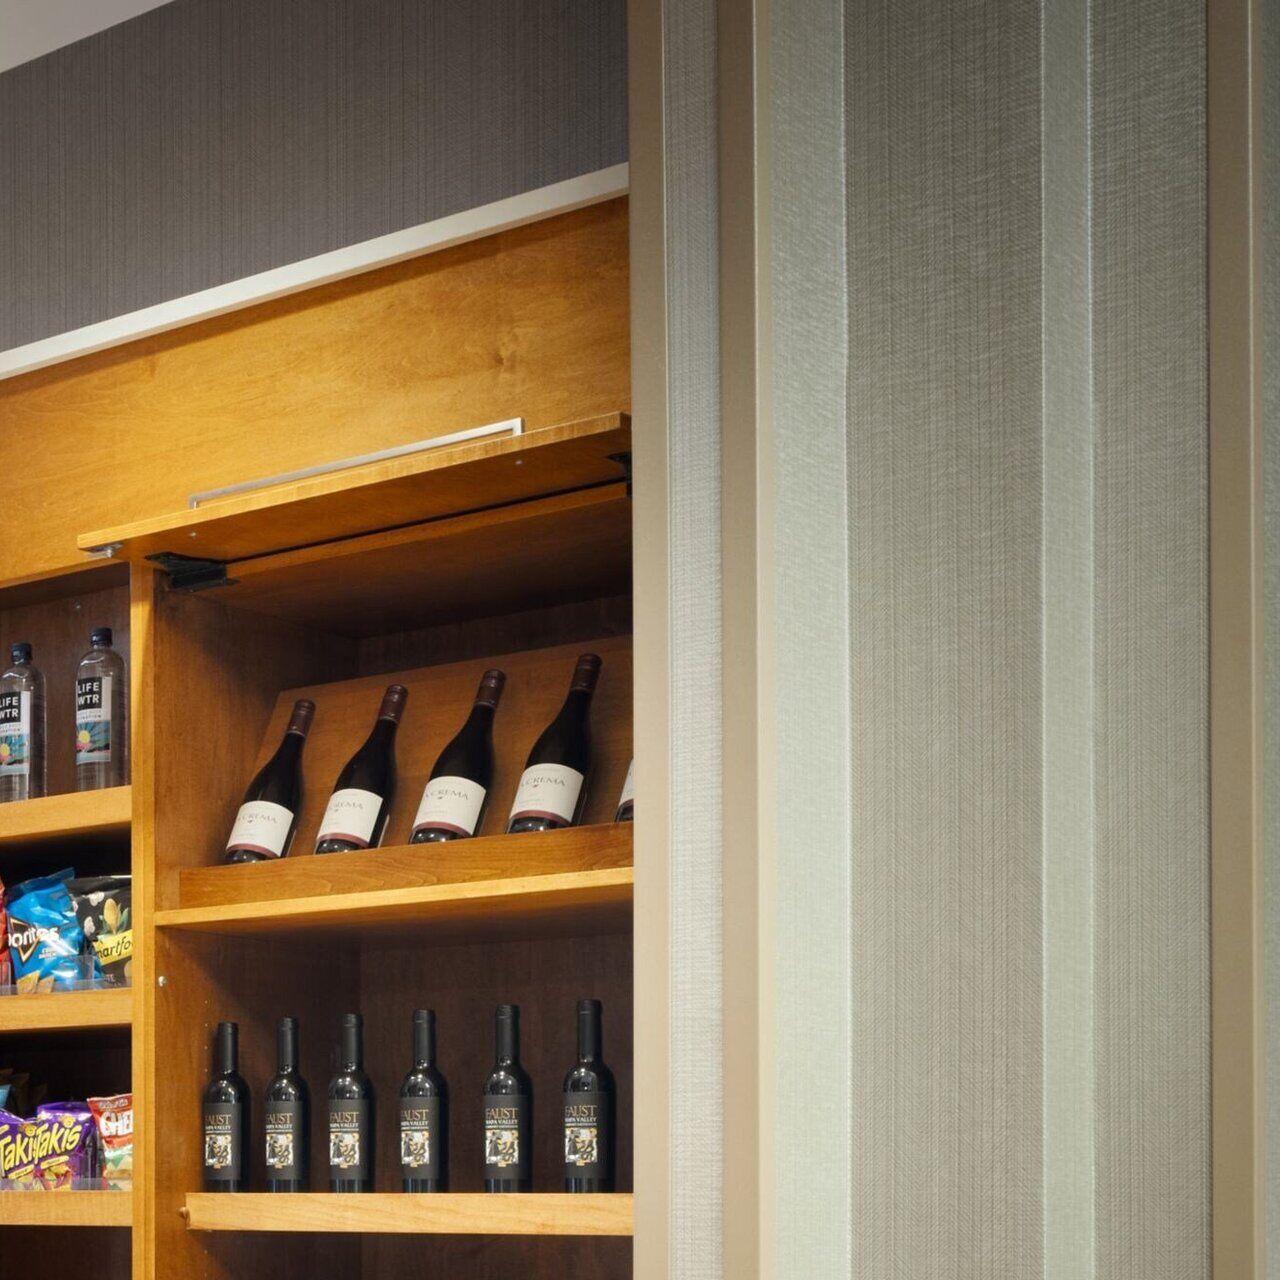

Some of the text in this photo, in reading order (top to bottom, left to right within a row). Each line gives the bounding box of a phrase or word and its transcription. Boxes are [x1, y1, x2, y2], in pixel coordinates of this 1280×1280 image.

[78, 682, 99, 694] LIFE
[0, 696, 19, 708] LIFE
[78, 694, 99, 705] WTR
[0, 709, 19, 719] WTR
[7, 927, 60, 947] oritos
[485, 1107, 518, 1120] FAUST
[565, 1104, 598, 1117] FAUST
[34, 1123, 82, 1164] Takis
